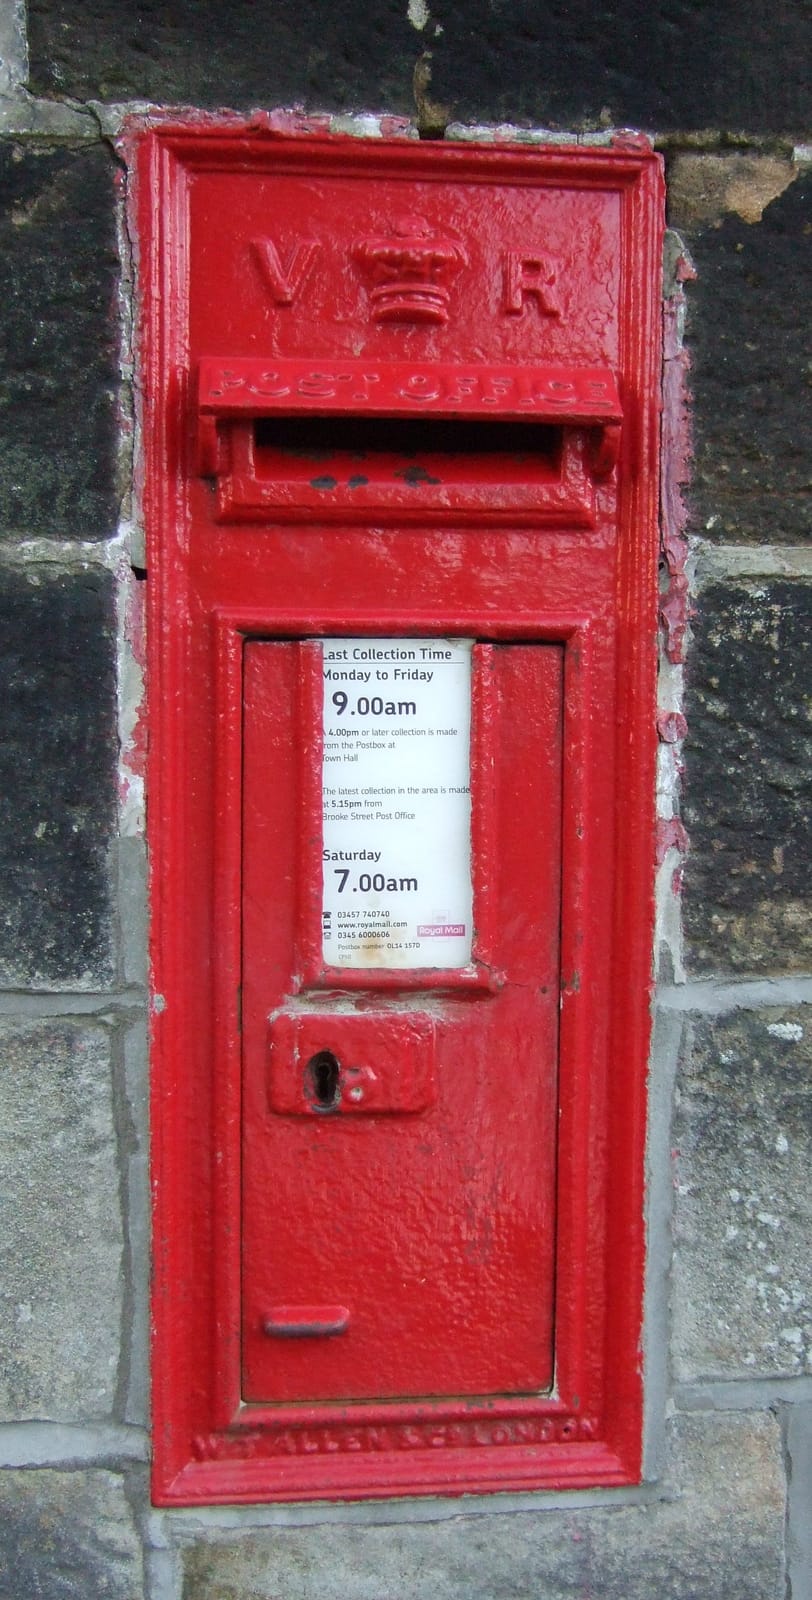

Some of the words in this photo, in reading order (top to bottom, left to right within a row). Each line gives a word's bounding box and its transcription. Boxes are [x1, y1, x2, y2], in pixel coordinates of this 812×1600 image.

[249, 236, 321, 307] V
[501, 248, 564, 320] R
[209, 370, 382, 401] POST
[396, 374, 615, 408] OFFICE
[353, 648, 416, 660] Collection
[419, 648, 452, 660] Time
[376, 670, 389, 681] to
[394, 669, 434, 683] Friday
[332, 691, 417, 716] 9.00am
[328, 728, 360, 737] 4.00pm
[371, 728, 390, 736] later
[391, 728, 426, 736] collection
[428, 728, 435, 736] is
[436, 728, 458, 736] made
[323, 742, 340, 750] rom
[341, 741, 354, 749] the
[356, 741, 386, 749] Postbox
[388, 741, 396, 749] at
[343, 754, 359, 762] Hall
[322, 787, 337, 795] The
[338, 787, 359, 795] latest
[361, 786, 396, 795] collection
[397, 786, 405, 795] in
[407, 786, 419, 794] the
[440, 786, 447, 794] is
[449, 786, 470, 794] made
[331, 800, 362, 809] 5.15pm
[364, 799, 383, 808] from
[350, 812, 374, 821] Street
[376, 812, 393, 820] Post
[394, 811, 416, 820] Office
[322, 849, 382, 863] Saturday
[334, 869, 418, 894] 7.00am
[337, 921, 408, 929] www.royalmail.com
[419, 926, 443, 936] Royal
[445, 925, 463, 935] Mail
[275, 1428, 386, 1452] ALLEN
[474, 1417, 598, 1446] LONDON
